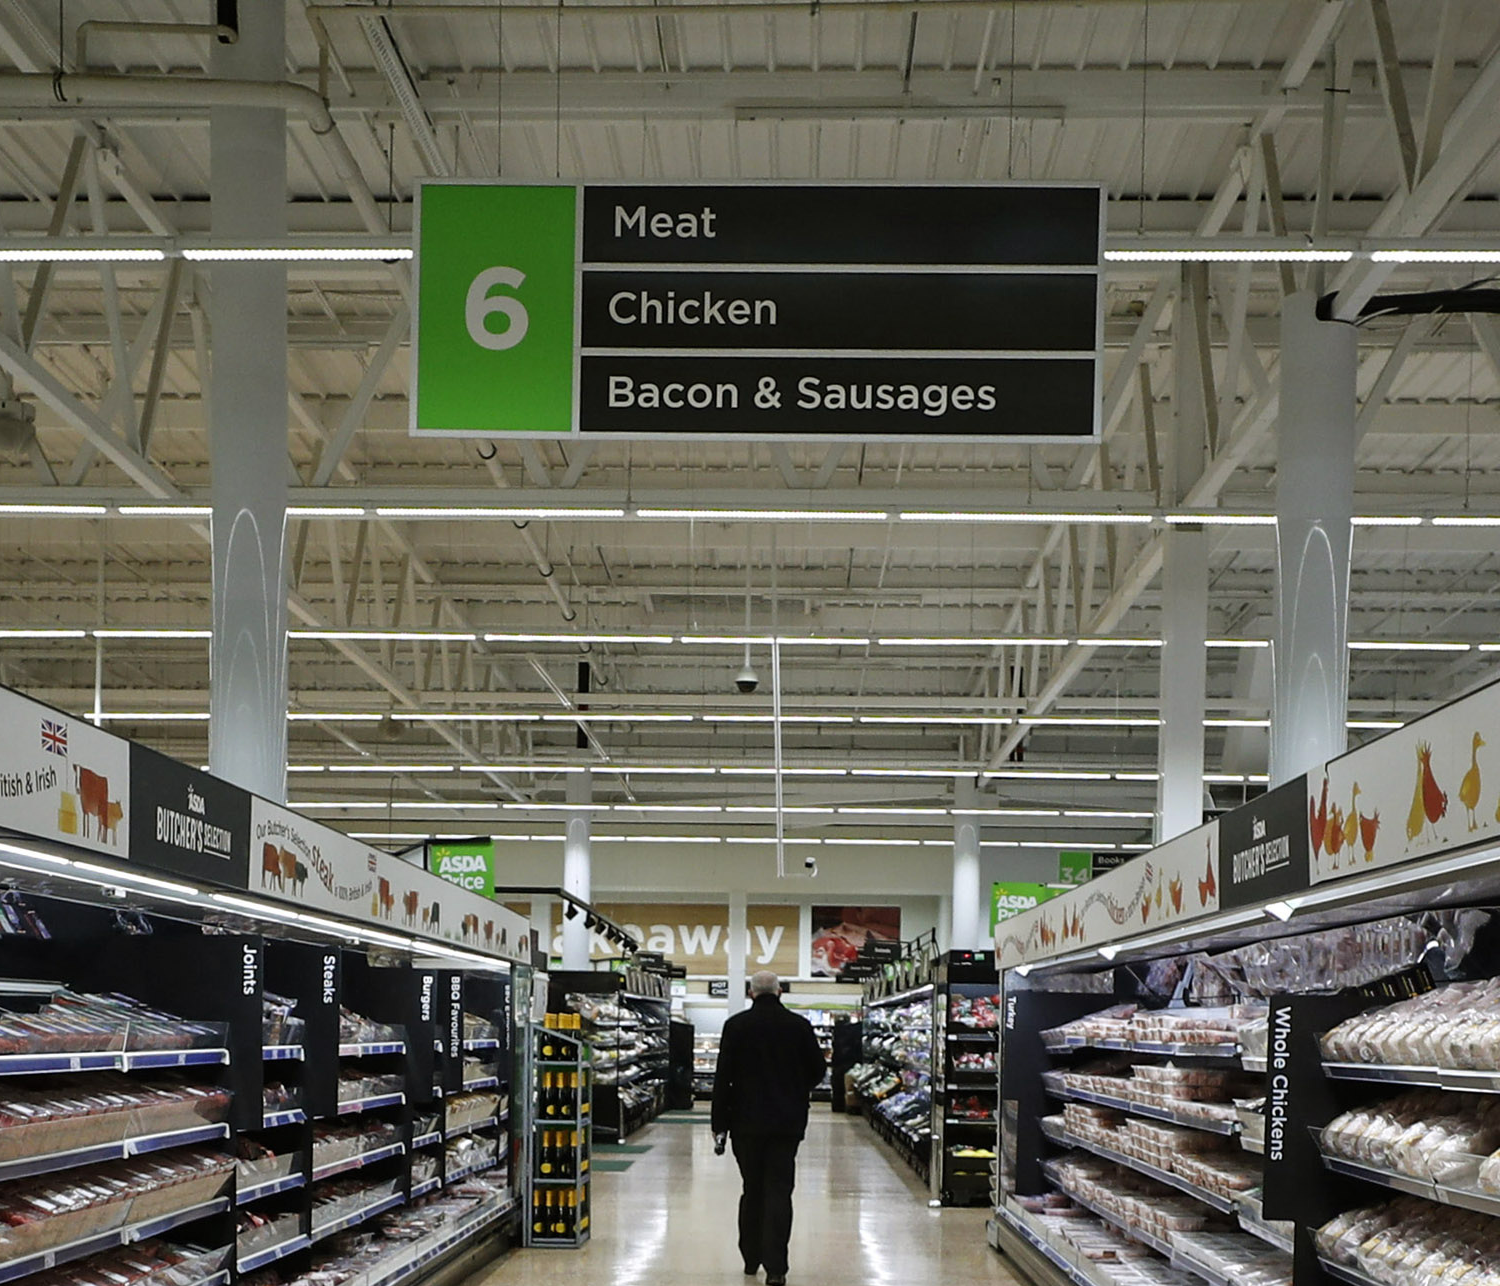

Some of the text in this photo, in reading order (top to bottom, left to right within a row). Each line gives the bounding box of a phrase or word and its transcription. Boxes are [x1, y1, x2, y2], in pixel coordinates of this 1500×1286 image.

[613, 205, 717, 239] Meat
[464, 265, 529, 351] 6
[608, 291, 777, 327] Chicken
[607, 375, 997, 415] Bacon & Sausages
[25, 772, 34, 795] &
[35, 765, 57, 790] Irish
[156, 805, 232, 854] BUTCHER'S SELECTION
[438, 855, 488, 873] ASDA
[441, 874, 485, 890] Price
[1061, 867, 1090, 884] 34
[997, 896, 1037, 909] ASDA
[242, 944, 258, 996] Joints
[323, 955, 336, 1004] Steaks
[420, 975, 434, 1022] Burgers
[450, 976, 462, 1058] BBQ Favourites
[1006, 996, 1017, 1030] Turkey
[1271, 1006, 1291, 1161] Whole Chickens
